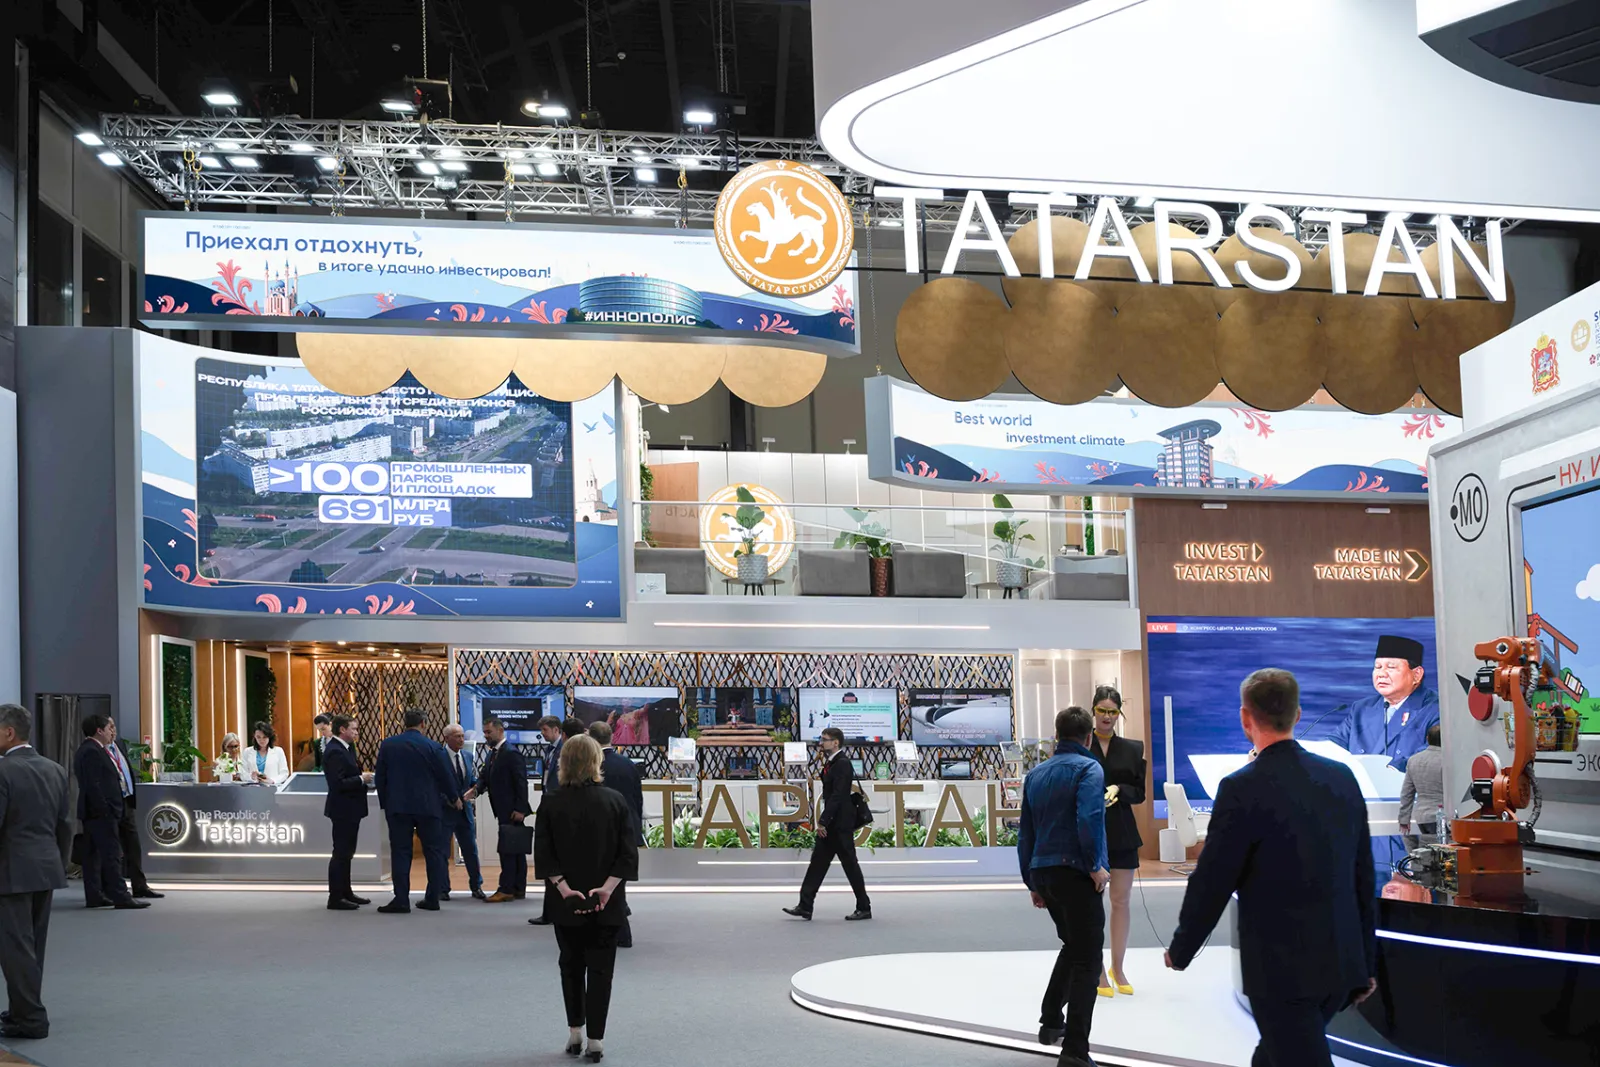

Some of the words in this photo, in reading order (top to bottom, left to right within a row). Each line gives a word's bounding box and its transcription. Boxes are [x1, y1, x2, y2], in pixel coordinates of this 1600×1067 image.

[185, 230, 289, 253] Приехал
[294, 236, 424, 260] отдохнуть,
[873, 187, 1508, 302] TATARSTAN
[318, 262, 327, 272] в
[330, 262, 374, 276] итоге
[377, 264, 435, 278] удачно
[438, 265, 552, 280] инвестировал!
[752, 278, 826, 295] ТАТАРСТАН
[583, 310, 697, 326] #ИННОПОЛИС
[197, 373, 289, 392] РЕСПУБЛИКА
[254, 392, 401, 406] ПРИВЛЕКАТЕЛЬНОСТИ
[403, 397, 446, 407] СРЕДИ
[448, 398, 516, 408] РЕГИОНОВ
[301, 404, 389, 417] РОССИЙСКОЙ
[391, 407, 473, 418] ФЕДЕРАЦИИ
[954, 411, 985, 425] Best
[988, 414, 1033, 426] world
[1006, 432, 1076, 445] investment
[1079, 434, 1126, 446] climate
[392, 463, 527, 475] ПРОМЫШЛЕННЫХ
[269, 463, 387, 493] >100
[392, 474, 453, 484] ПАРКОВ
[392, 484, 403, 494] И
[405, 484, 496, 497] ПЛОЩАДОК
[321, 498, 390, 522] 691
[393, 498, 451, 513] МЛРД
[393, 513, 435, 526] РУБ
[1184, 542, 1249, 561] INVEST
[1334, 547, 1380, 564] MADE
[1384, 548, 1402, 564] IN
[1173, 563, 1271, 582] TATARSTAN
[1314, 564, 1402, 581] TATARSTAN
[193, 809, 212, 820] The
[213, 809, 258, 822] Republic
[259, 809, 271, 820] of
[196, 821, 305, 844] Tatarstan
